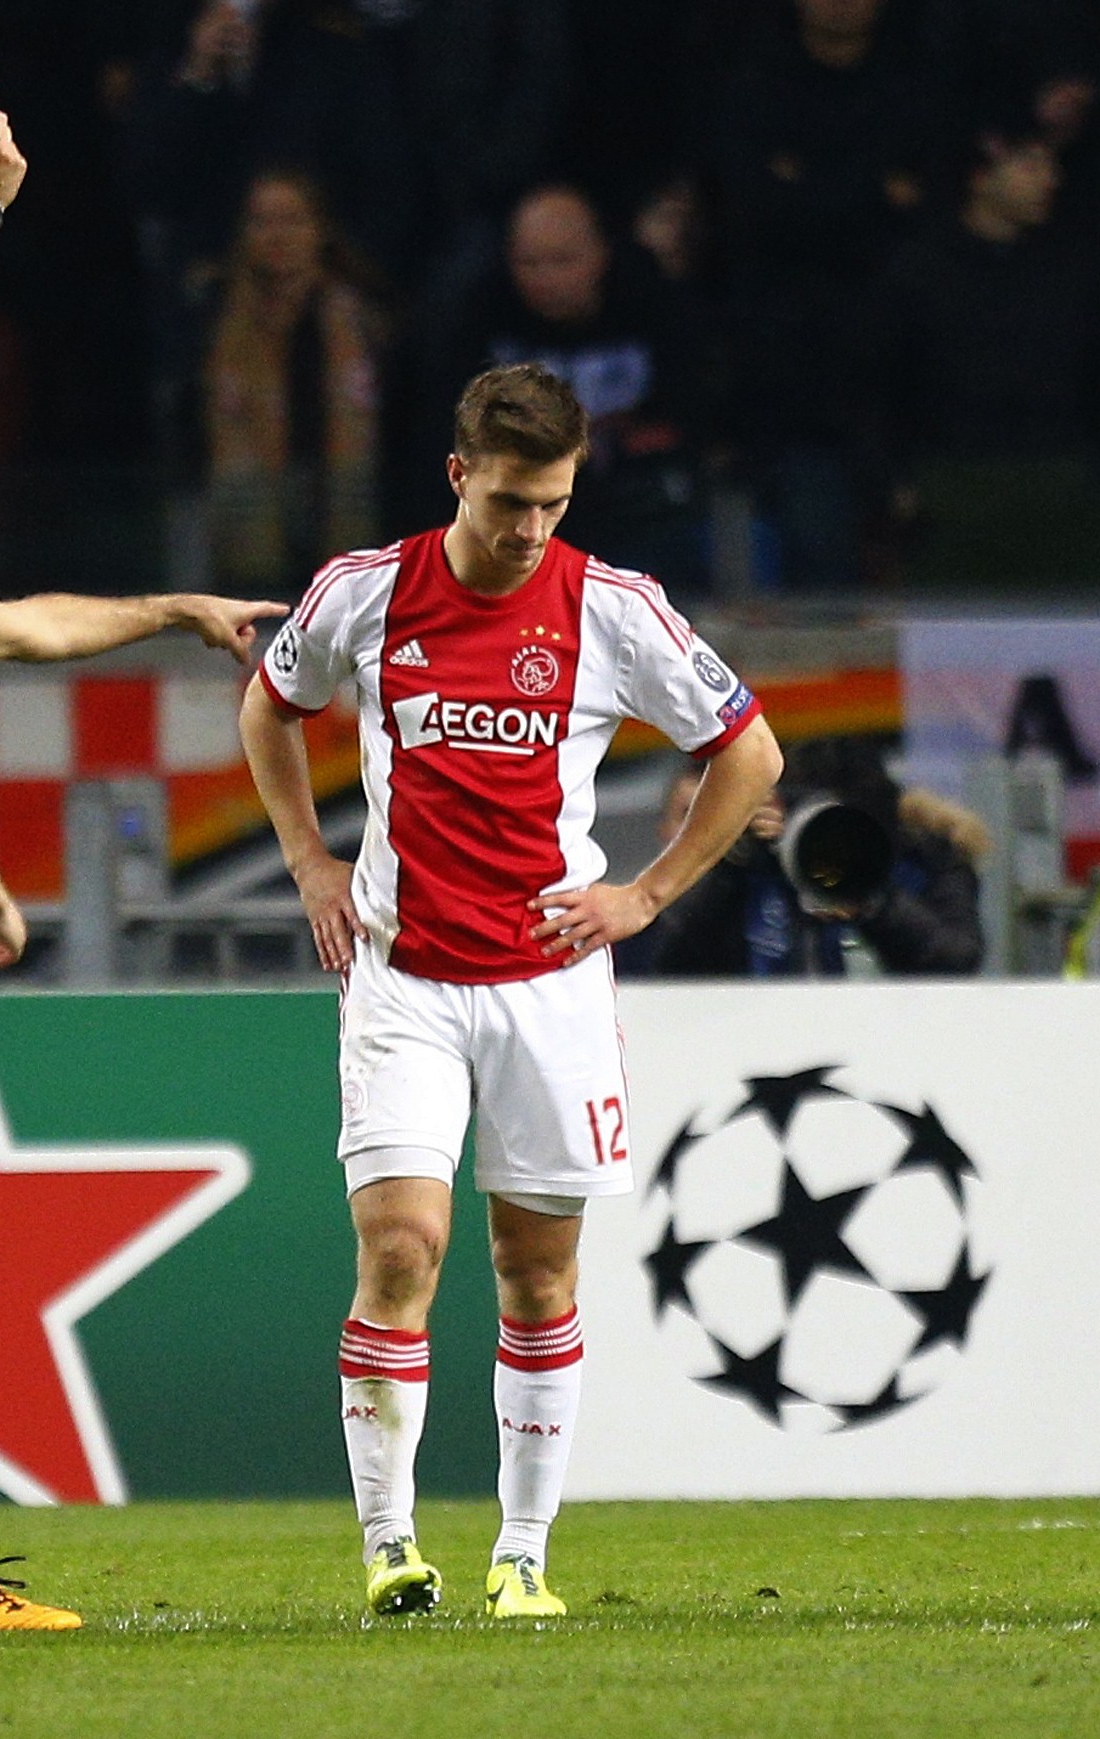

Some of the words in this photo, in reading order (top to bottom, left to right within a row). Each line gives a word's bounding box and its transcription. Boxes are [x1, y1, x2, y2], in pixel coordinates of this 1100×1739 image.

[420, 690, 559, 747] AEGON
[586, 1097, 627, 1166] 12
[502, 1417, 562, 1437] AJAX
